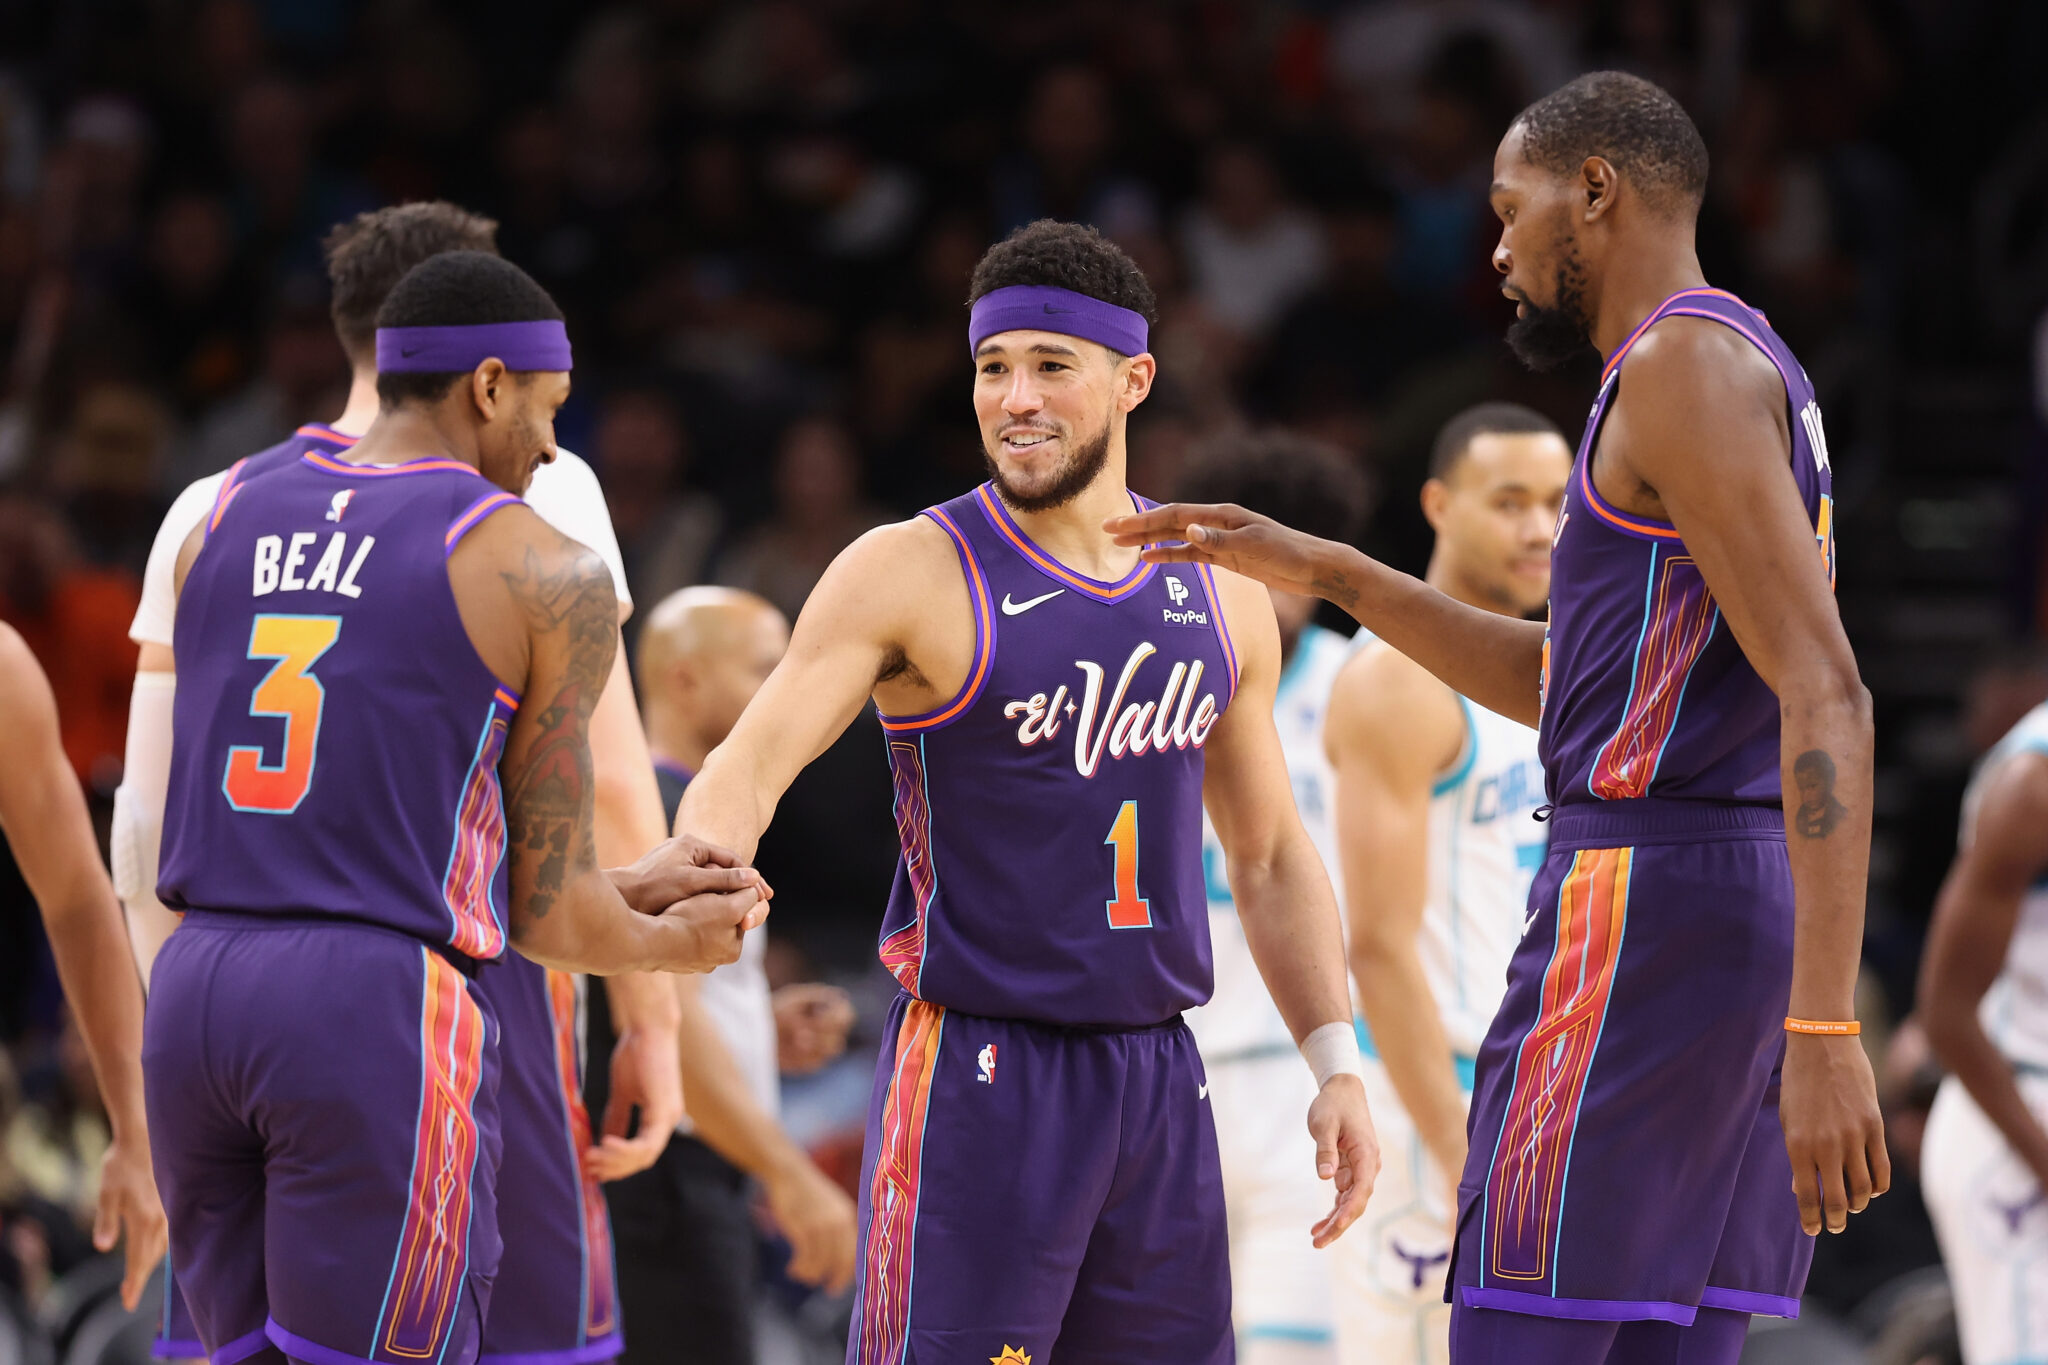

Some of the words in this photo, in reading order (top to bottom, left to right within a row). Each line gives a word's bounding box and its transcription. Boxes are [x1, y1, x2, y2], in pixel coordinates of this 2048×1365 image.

[253, 531, 376, 599] BEAL
[1163, 608, 1208, 625] PayPal
[221, 613, 343, 815] 3
[1003, 682, 1068, 746] El
[1074, 641, 1219, 779] Valle
[1104, 800, 1153, 930] 1
